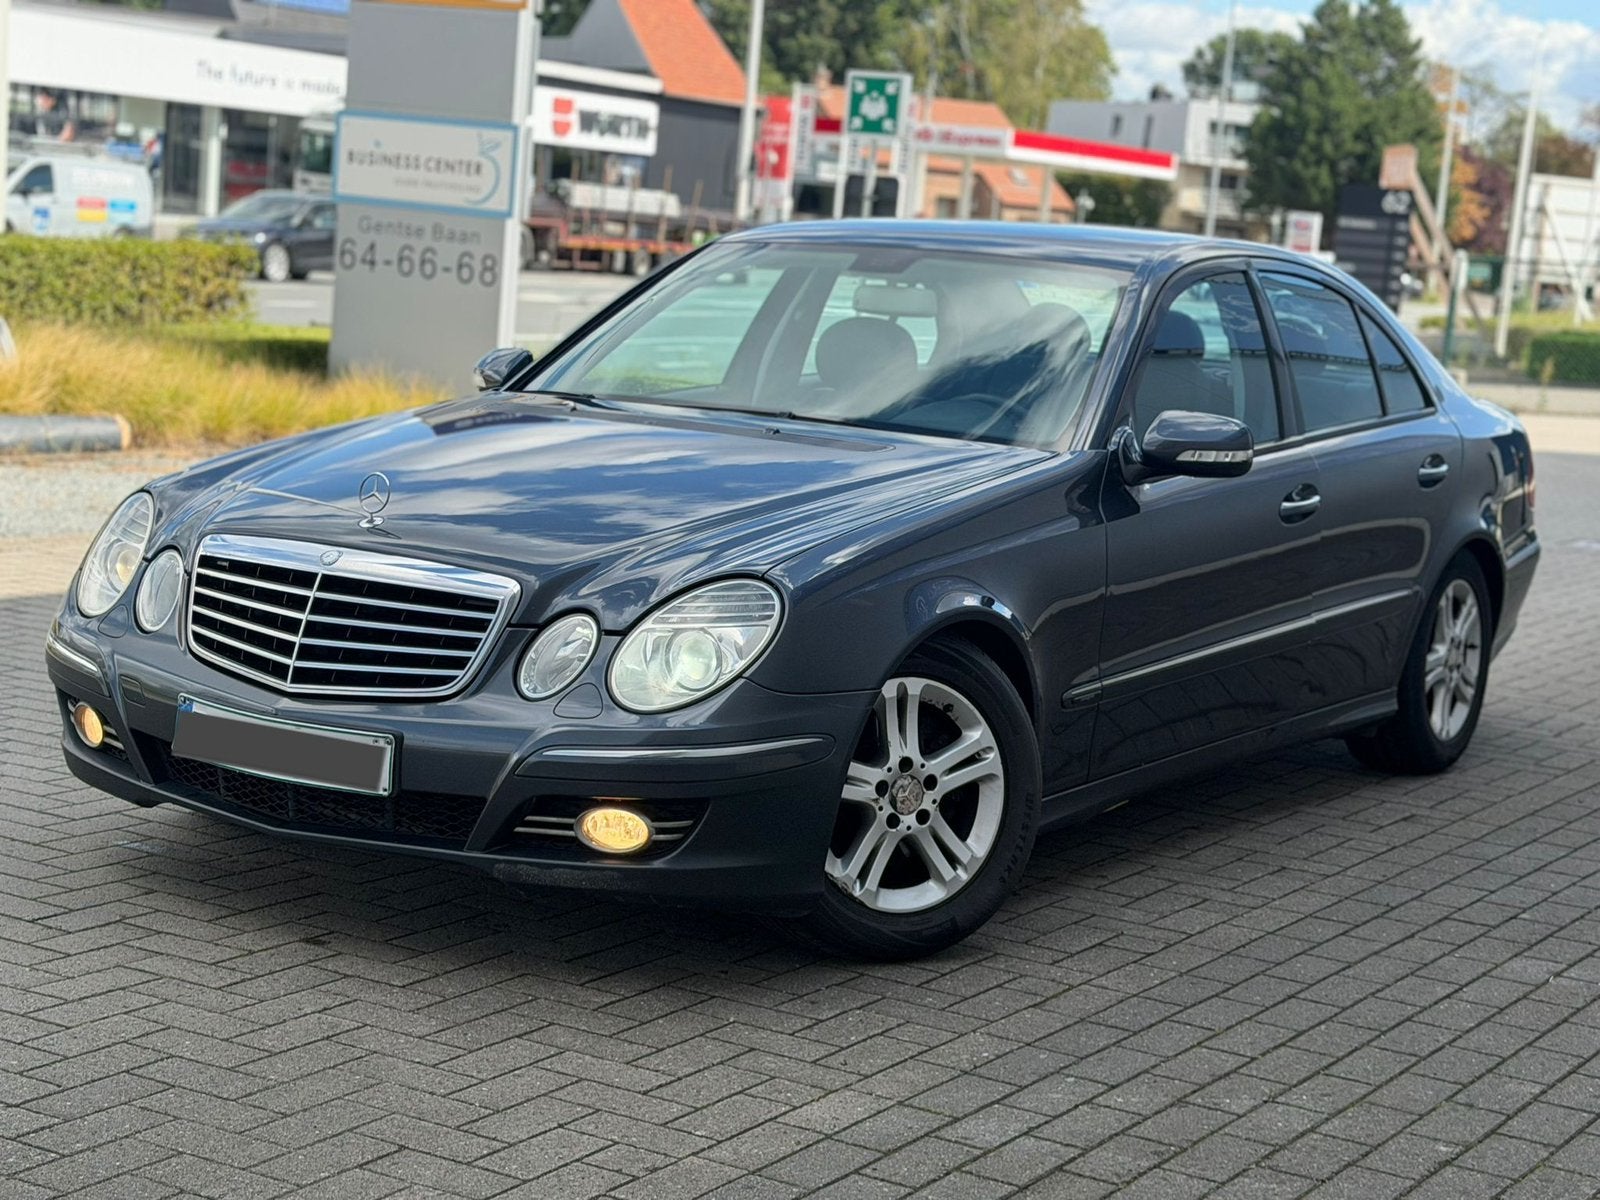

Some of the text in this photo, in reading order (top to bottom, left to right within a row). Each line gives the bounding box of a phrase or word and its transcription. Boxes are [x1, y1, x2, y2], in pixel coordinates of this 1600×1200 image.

[347, 149, 483, 176] BUSINESS CENTER
[1381, 191, 1411, 215] 62
[358, 215, 482, 245] Gentse Baan
[338, 237, 498, 288] 64-66-68
